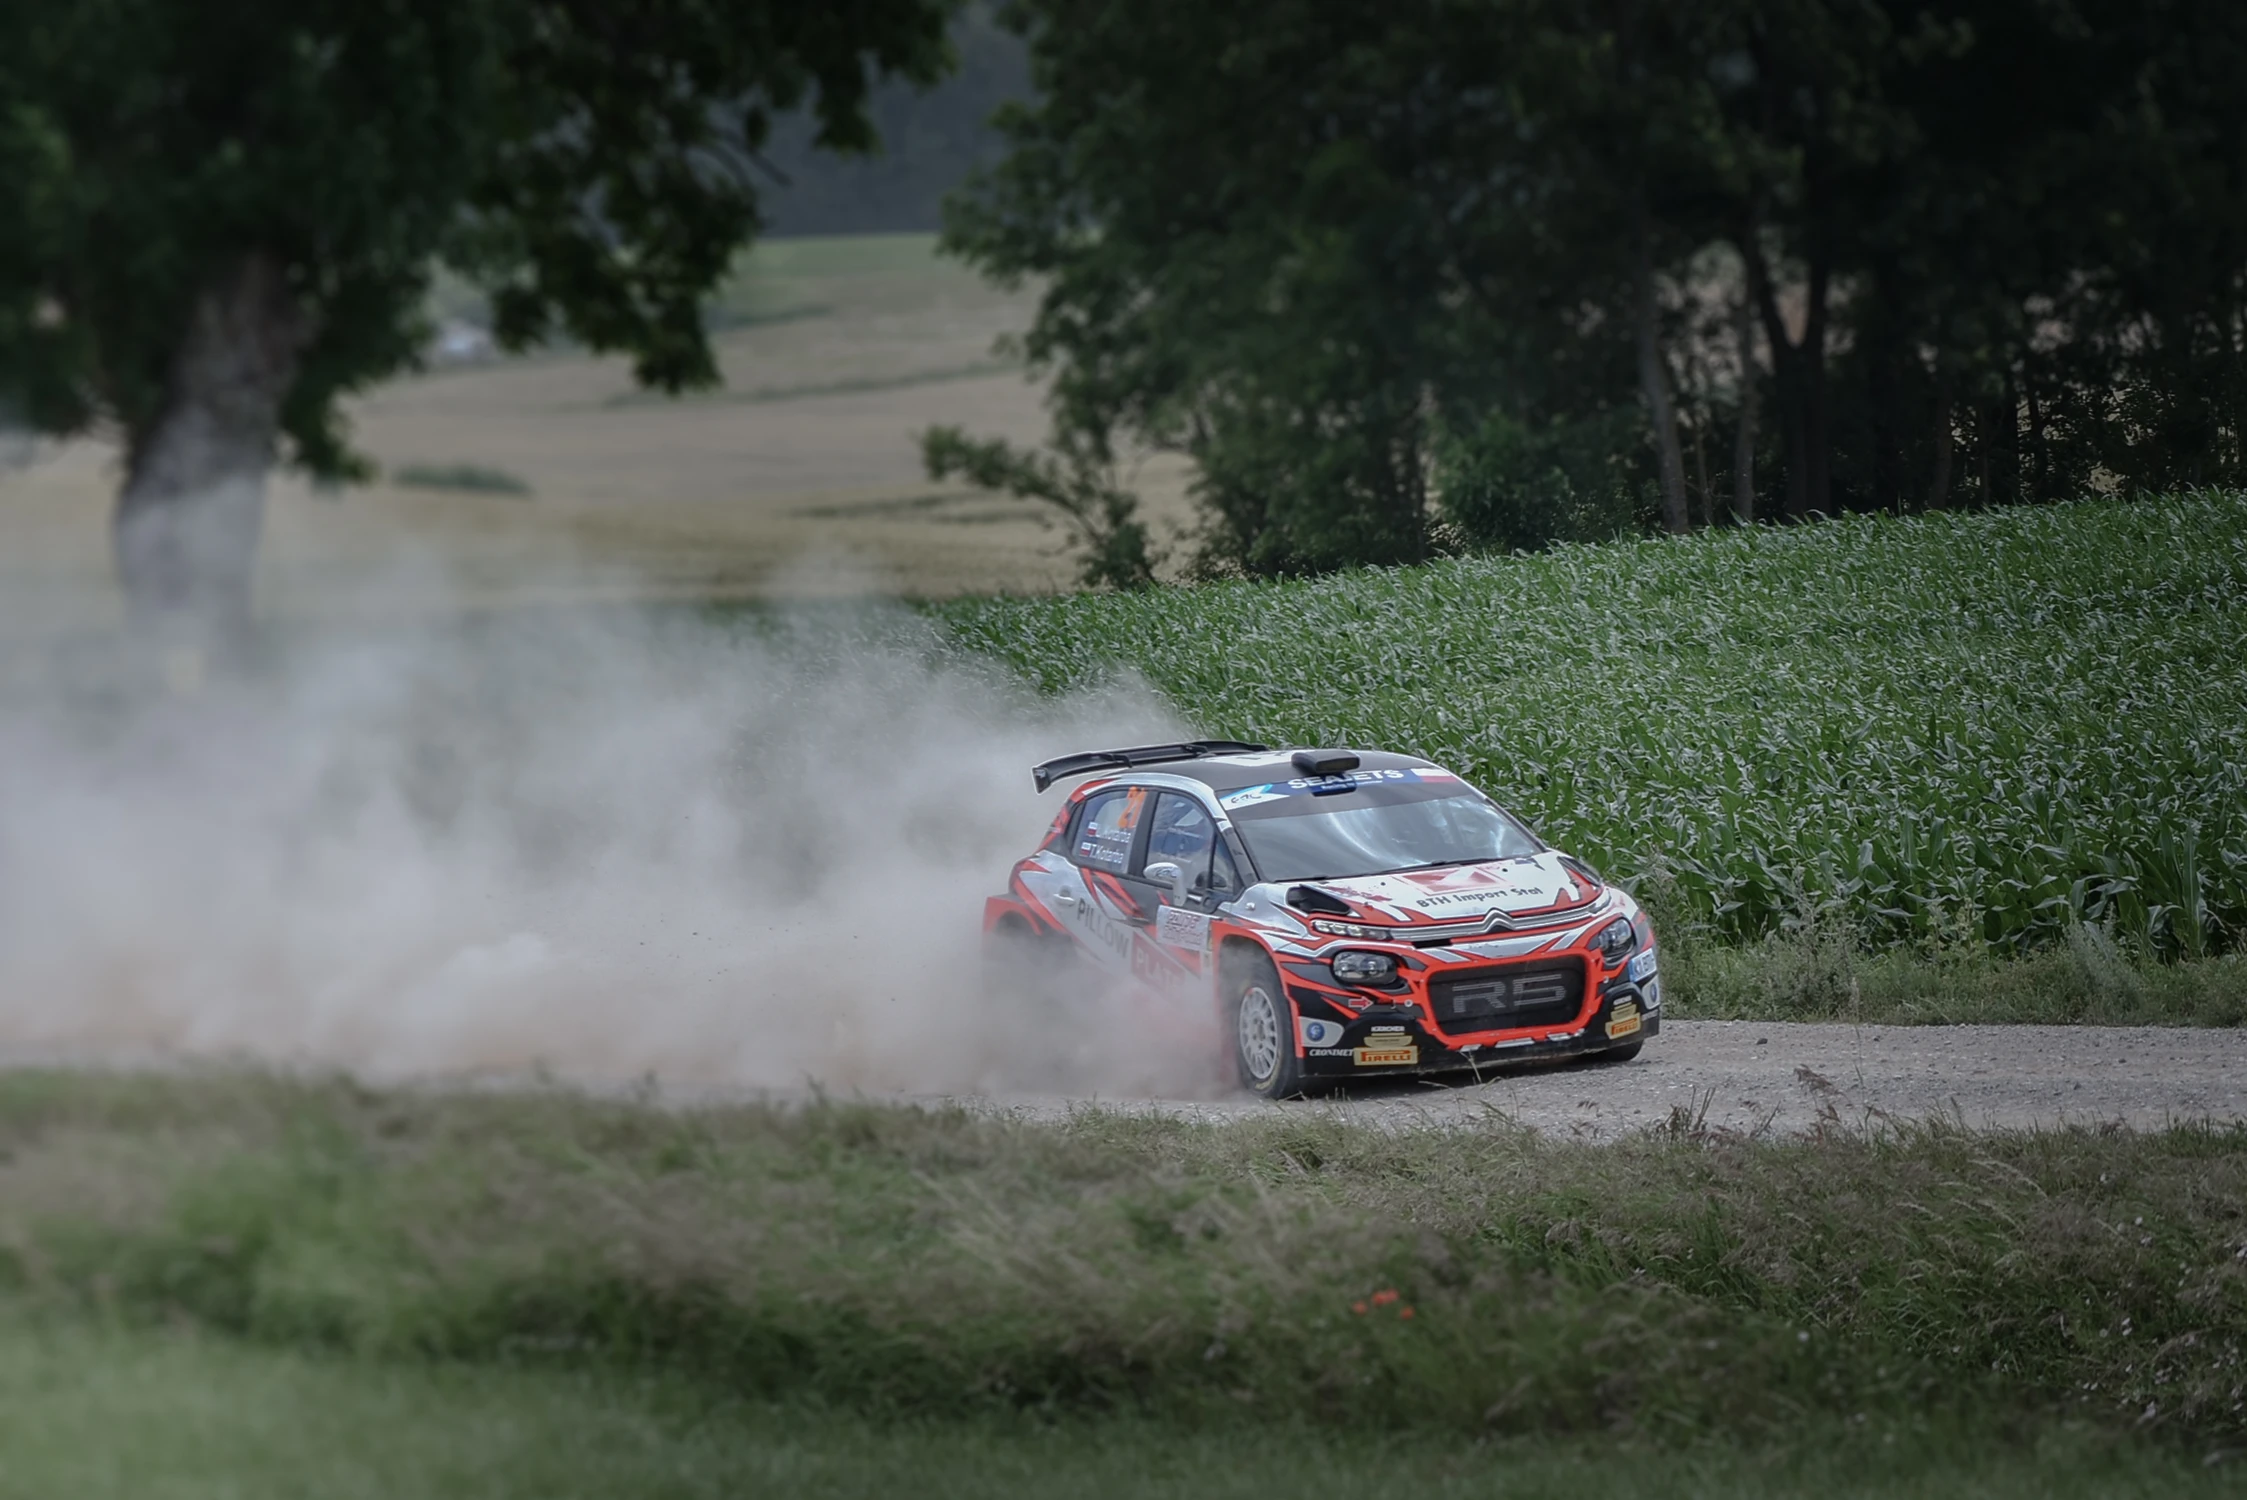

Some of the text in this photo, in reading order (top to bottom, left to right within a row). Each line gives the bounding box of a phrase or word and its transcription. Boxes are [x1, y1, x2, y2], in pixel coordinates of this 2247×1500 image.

[1416, 886, 1544, 908] BTH Import Stal
[1076, 897, 1130, 959] PILLOW
[1451, 973, 1567, 1013] R5
[1360, 1049, 1412, 1062] PIRELLI
